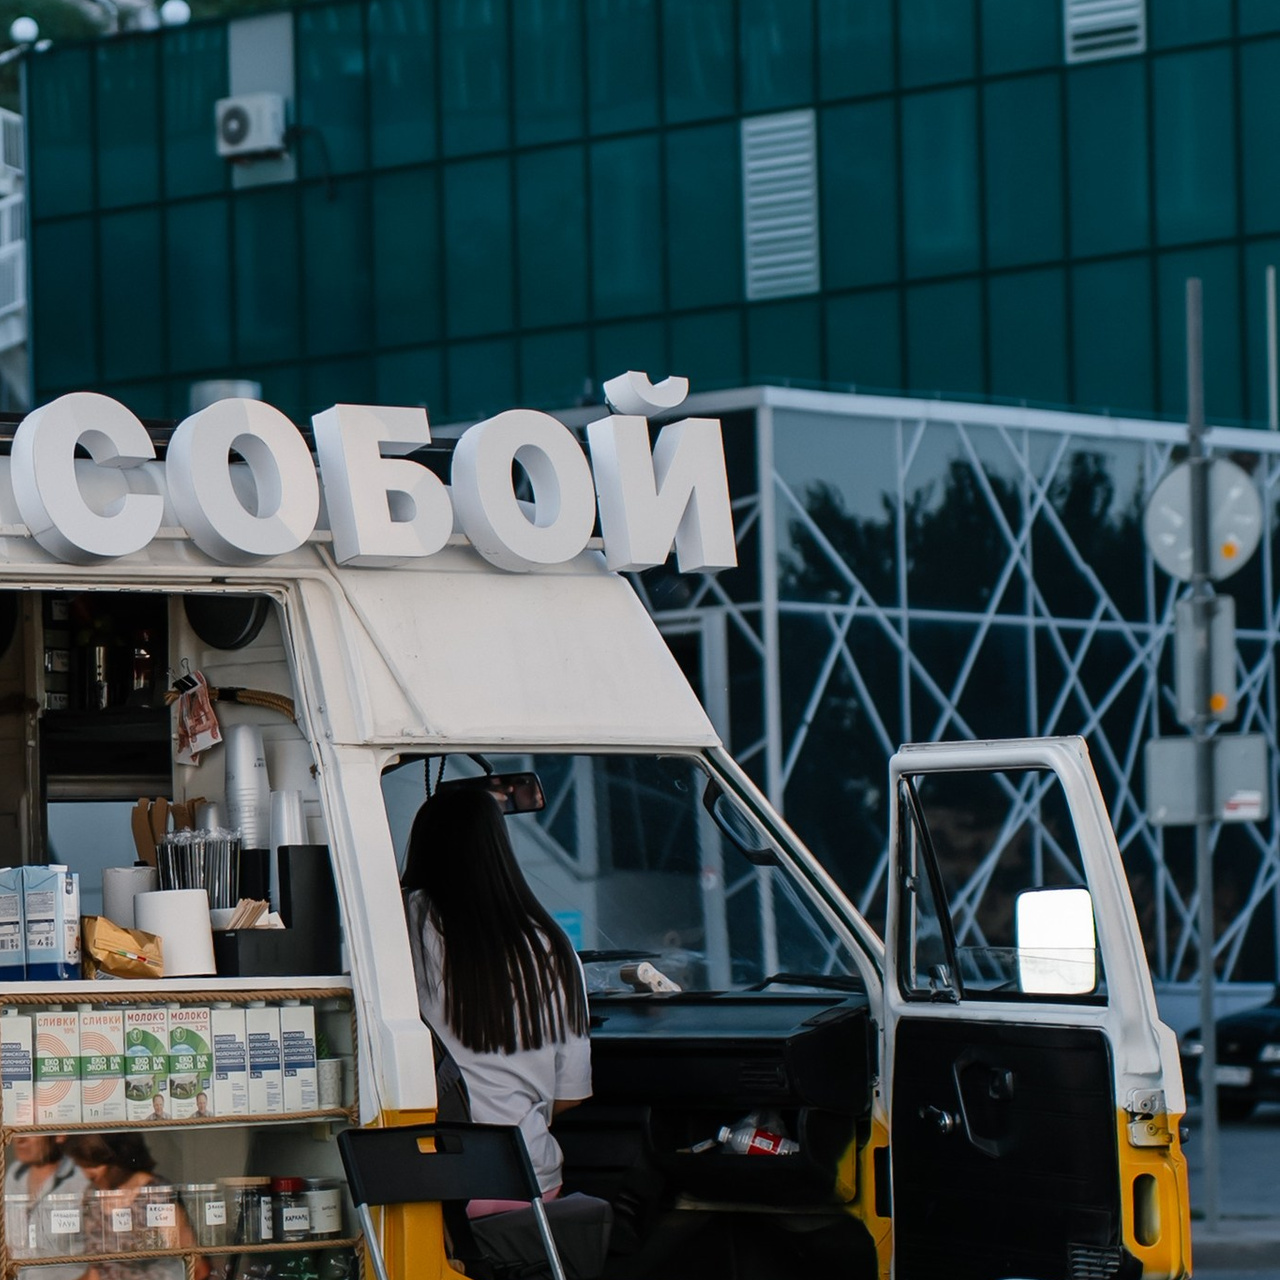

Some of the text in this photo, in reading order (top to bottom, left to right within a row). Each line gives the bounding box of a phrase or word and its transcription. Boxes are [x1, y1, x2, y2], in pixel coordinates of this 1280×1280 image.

[10, 370, 738, 574] СОБОЙ
[83, 1015, 121, 1026] СЛИВКИ
[127, 1012, 165, 1022] МОЛОКО
[171, 1010, 208, 1020] МОЛОКО
[38, 1016, 76, 1027] СЛИВКИ
